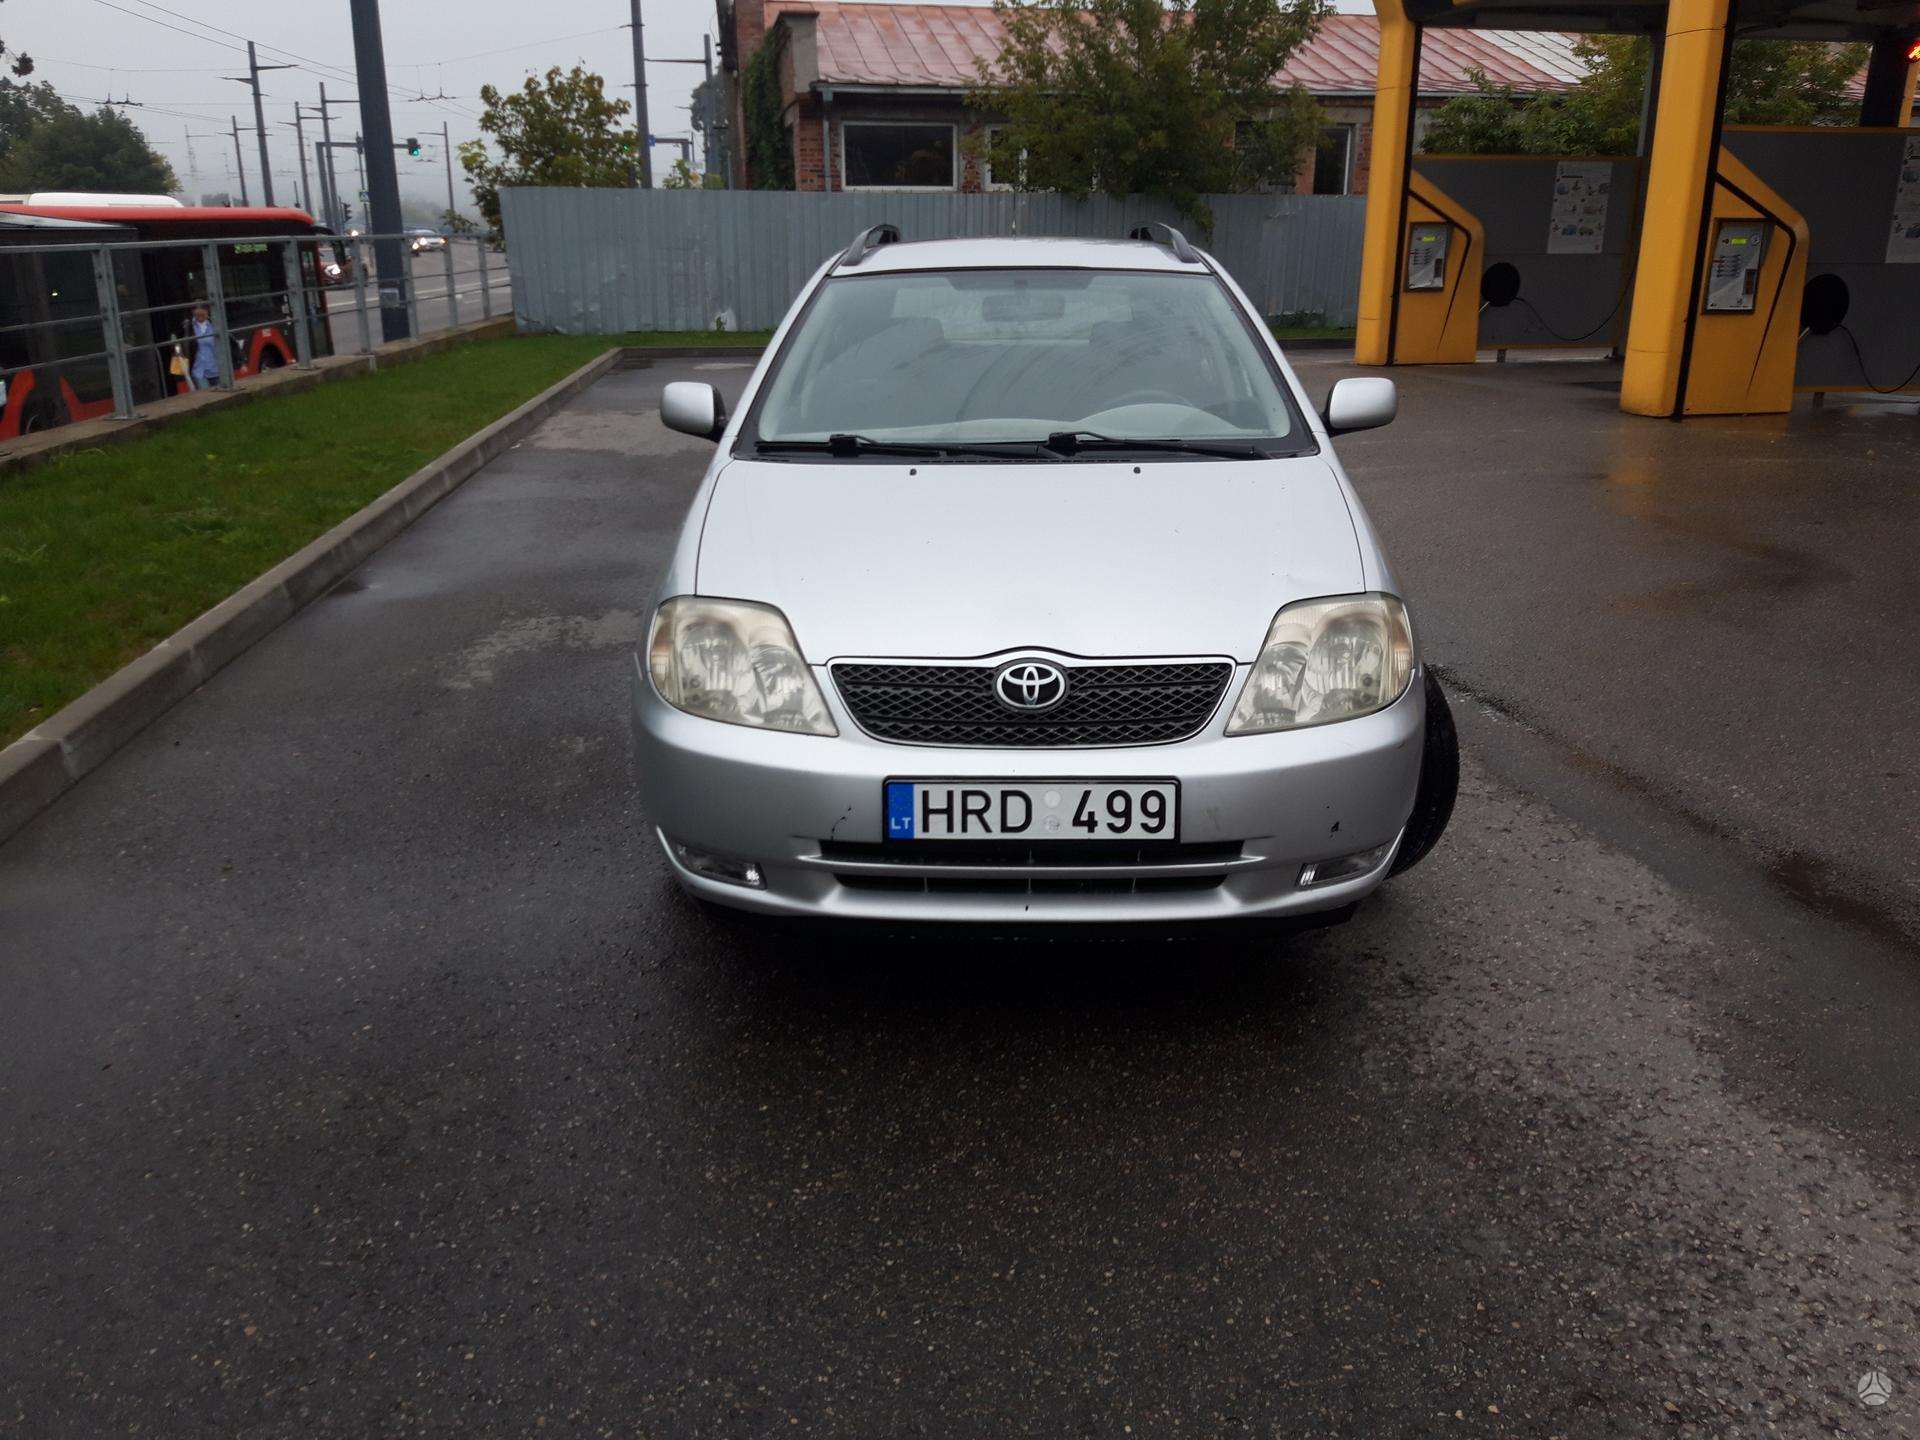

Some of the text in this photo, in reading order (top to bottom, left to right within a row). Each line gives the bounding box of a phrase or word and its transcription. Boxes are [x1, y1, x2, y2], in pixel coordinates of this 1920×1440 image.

[891, 817, 911, 829] LT
[922, 790, 1166, 833] HRD 499
